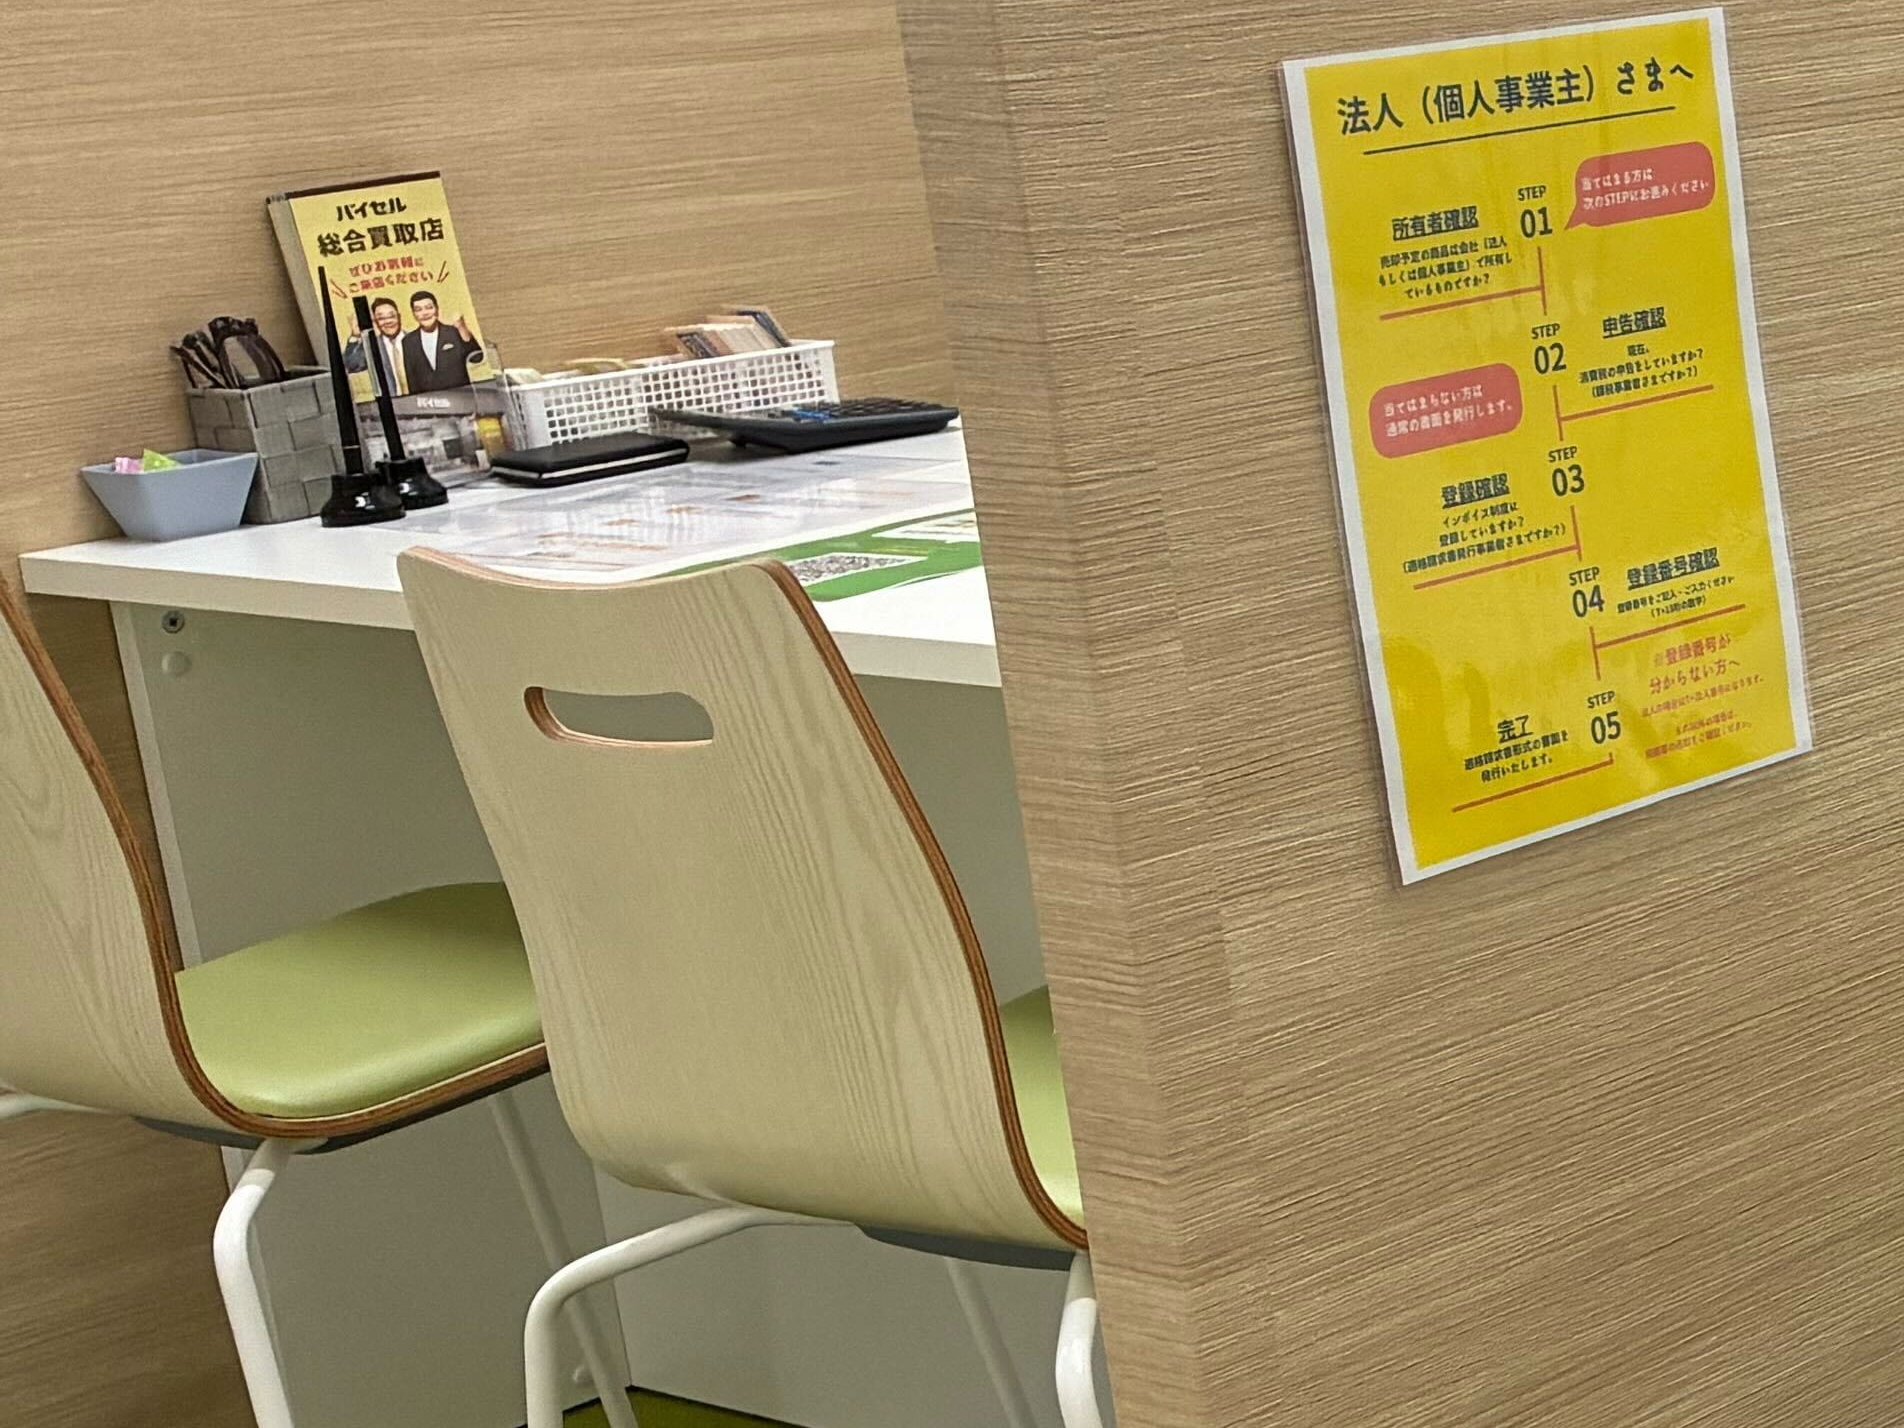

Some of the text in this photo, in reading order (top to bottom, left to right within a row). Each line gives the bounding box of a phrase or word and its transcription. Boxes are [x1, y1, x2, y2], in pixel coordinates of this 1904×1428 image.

[336, 197, 407, 221] バイセル
[1517, 185, 1547, 202] STEP
[317, 217, 444, 257] 総合買取店
[1392, 205, 1480, 241] 所有者確認
[1520, 206, 1553, 238] 01
[1531, 322, 1561, 340] STEP
[1602, 306, 1667, 339] 申告確認
[1533, 342, 1568, 374] 02
[1548, 446, 1578, 463] STEP
[1441, 472, 1511, 509] 登録確認
[1551, 464, 1585, 496] 03
[1568, 566, 1601, 586] STEP
[1627, 547, 1721, 591] 登録番号確認
[1572, 584, 1605, 618] 04
[1587, 690, 1616, 708] STEP
[1497, 714, 1534, 744] 完了
[1591, 710, 1622, 745] 05
